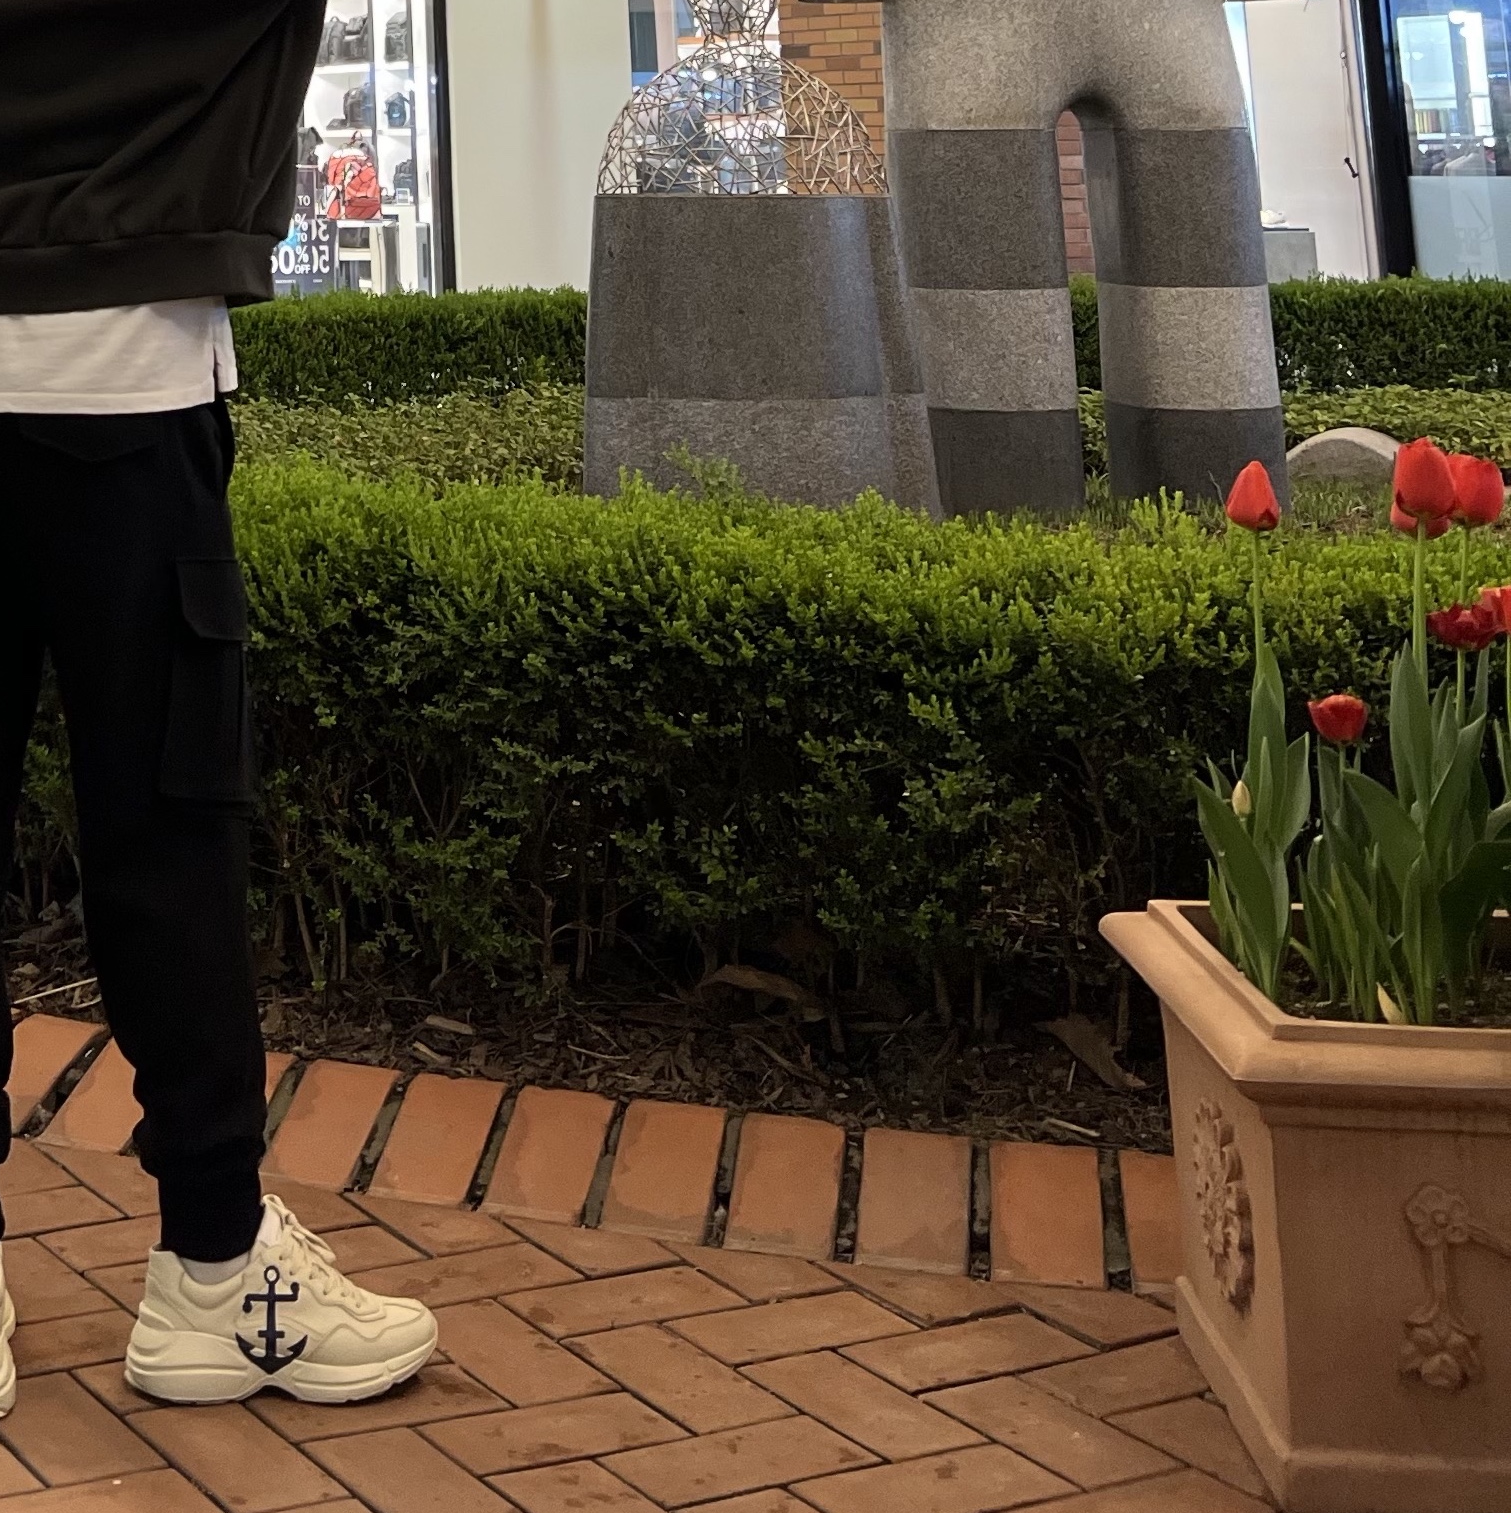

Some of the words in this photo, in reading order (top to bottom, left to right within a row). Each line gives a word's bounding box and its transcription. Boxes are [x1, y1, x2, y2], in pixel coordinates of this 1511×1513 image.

[297, 195, 311, 206] TO
[296, 232, 308, 243] TO
[294, 264, 311, 275] OFF
